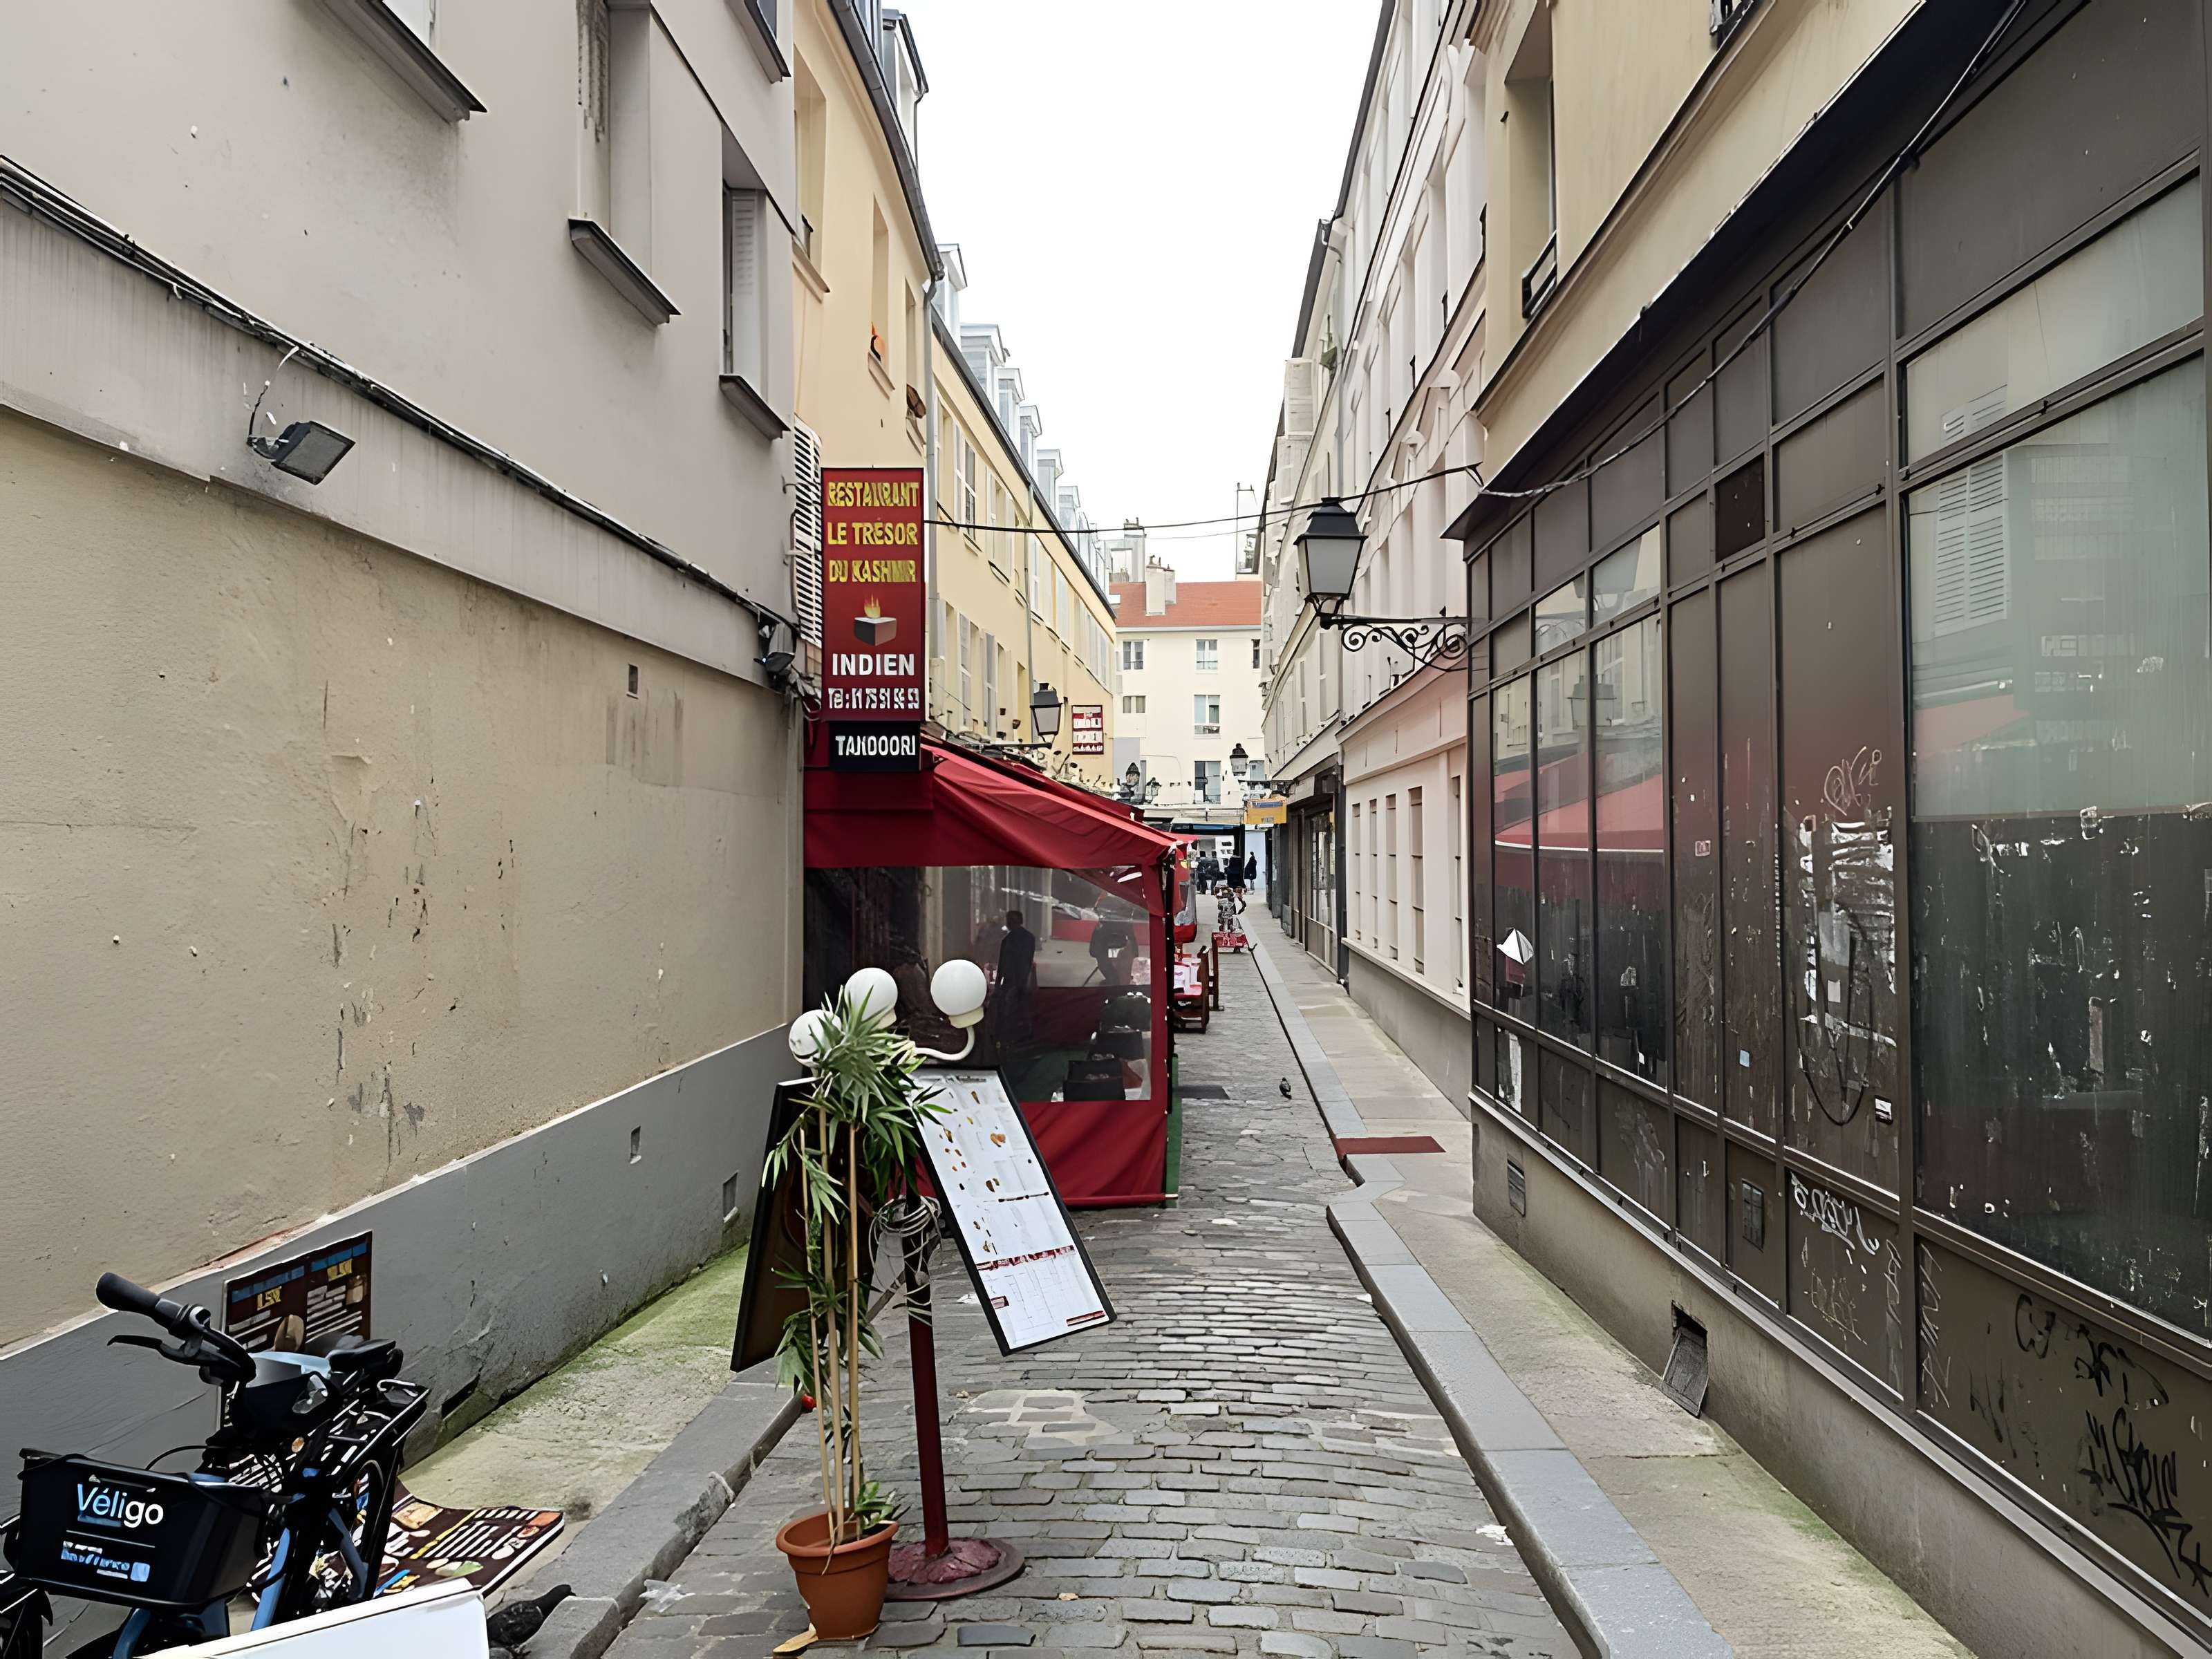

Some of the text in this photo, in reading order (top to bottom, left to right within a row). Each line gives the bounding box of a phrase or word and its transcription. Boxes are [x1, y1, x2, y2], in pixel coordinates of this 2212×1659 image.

[827, 481, 919, 507] RESTAURANT
[827, 521, 847, 545] LE
[829, 559, 849, 583] DU
[832, 653, 915, 676] INDIEN
[835, 735, 916, 756] TANDOORI
[77, 1483, 165, 1528] Véligo
